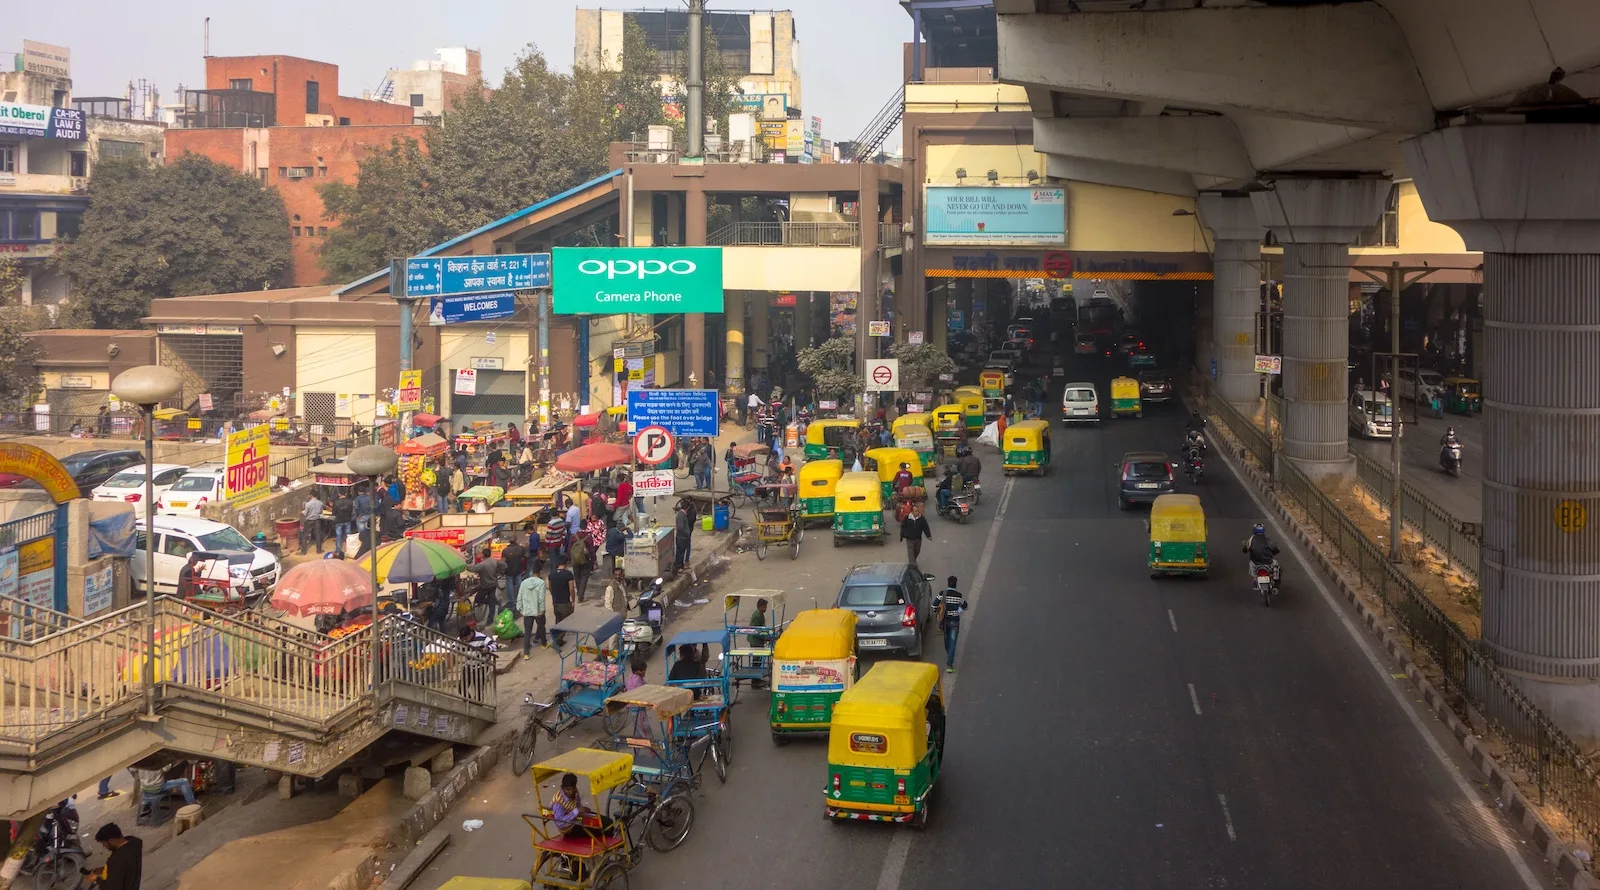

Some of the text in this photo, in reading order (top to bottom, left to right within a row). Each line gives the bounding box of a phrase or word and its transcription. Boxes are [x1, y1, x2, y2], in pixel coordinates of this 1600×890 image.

[0, 106, 45, 121] it Oberoi
[55, 109, 81, 119] CA-IPC
[54, 119, 74, 129] LAW
[75, 121, 81, 130] &
[55, 129, 81, 140] AUDIT
[447, 260, 469, 273] किशन
[487, 258, 499, 271] वार्ड
[509, 260, 520, 270] 221
[578, 260, 697, 280] oppo
[464, 278, 485, 288] आपका
[487, 276, 506, 287] स्वागत
[508, 272, 514, 286] है
[596, 290, 682, 302] Camera Phone
[464, 300, 498, 312] WELCOMES
[228, 443, 269, 493] पार्किंग
[635, 476, 672, 489] पार्किंग
